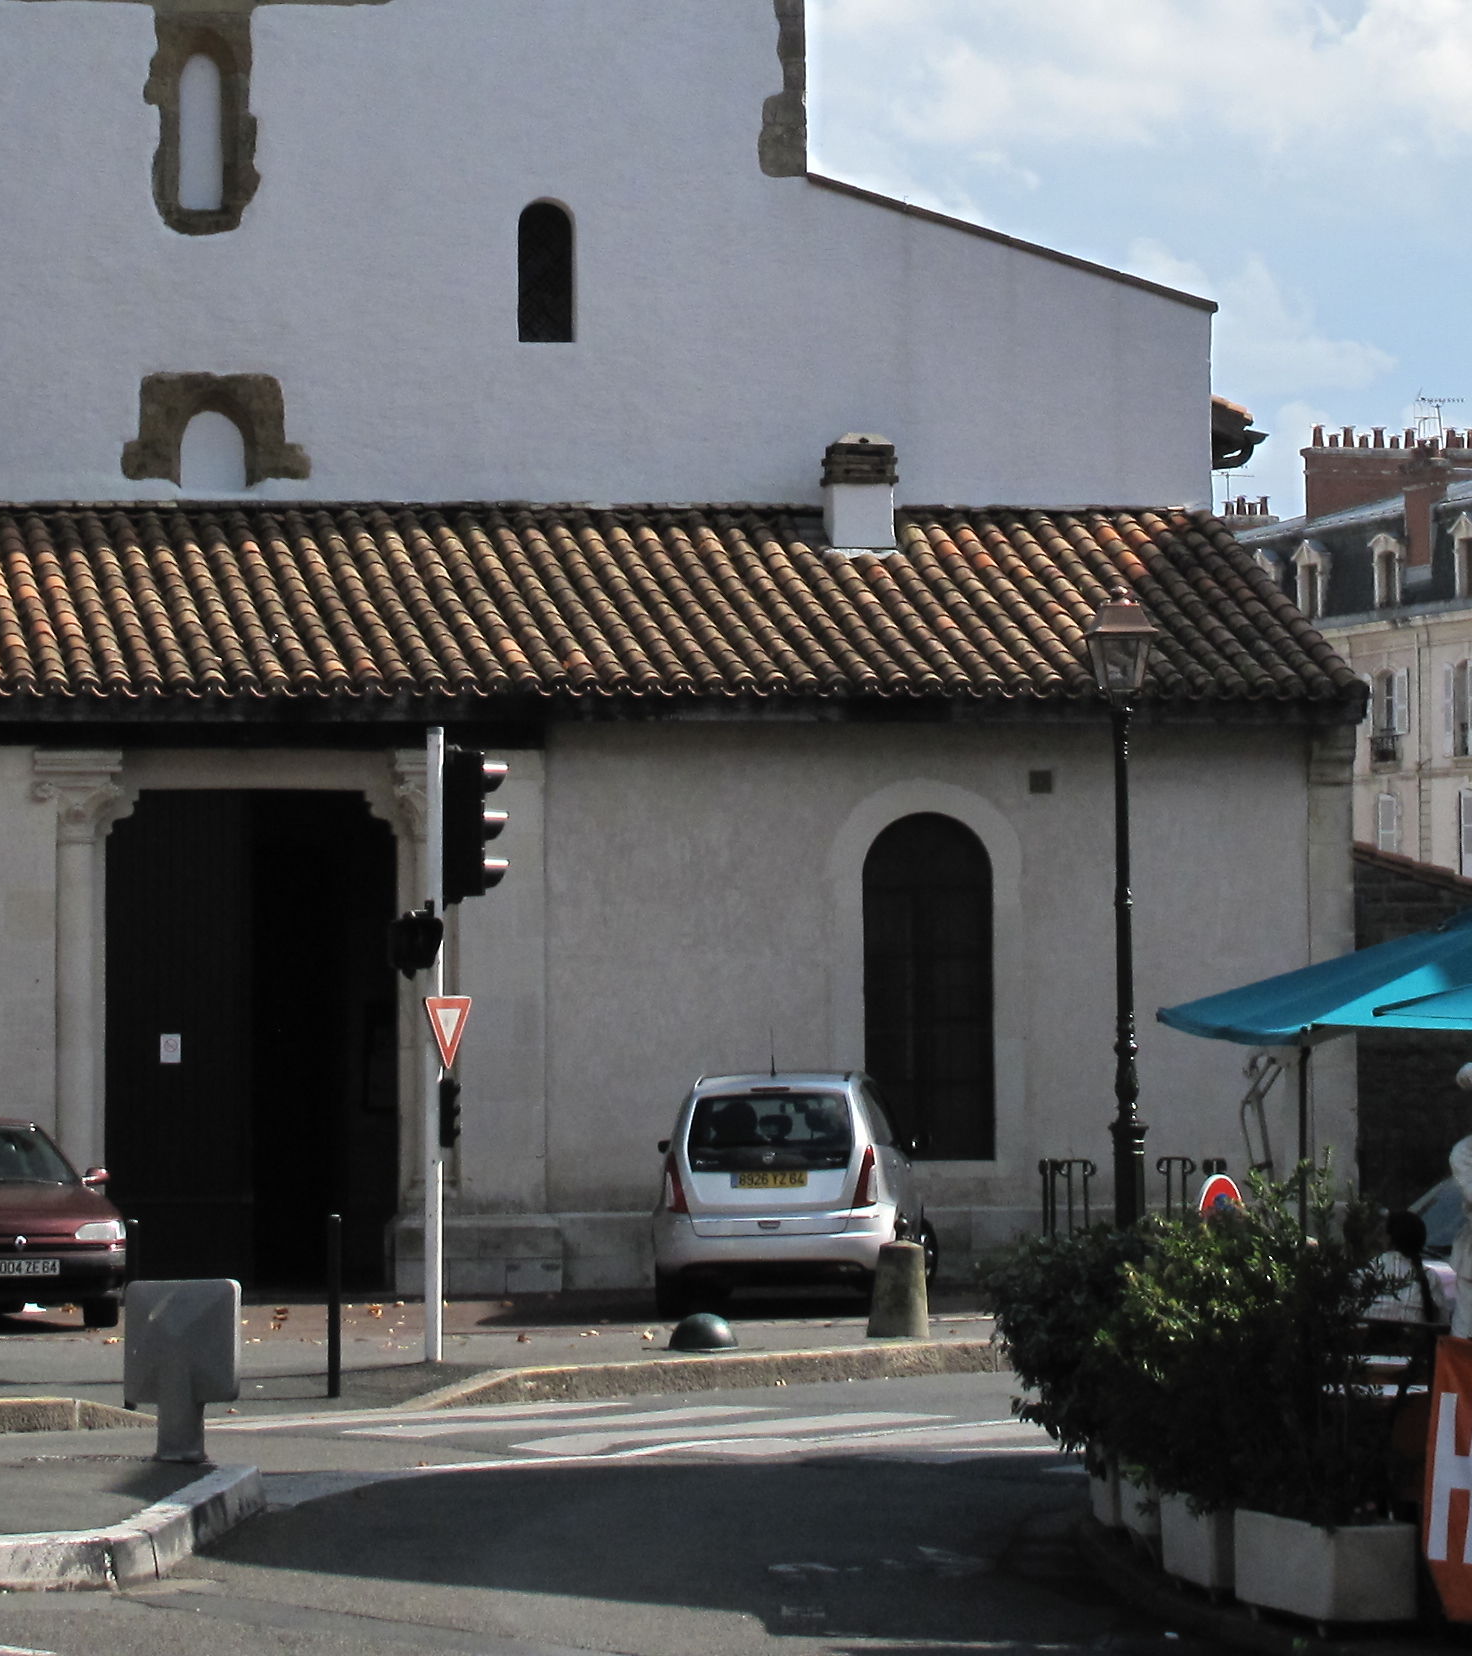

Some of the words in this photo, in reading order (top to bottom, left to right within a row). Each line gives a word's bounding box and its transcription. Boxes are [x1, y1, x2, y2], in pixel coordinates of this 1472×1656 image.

[739, 1171, 768, 1186] 8926
[773, 1171, 786, 1186] YZ
[789, 1170, 804, 1185] 64
[25, 1261, 40, 1274] ZE
[42, 1260, 57, 1274] 64
